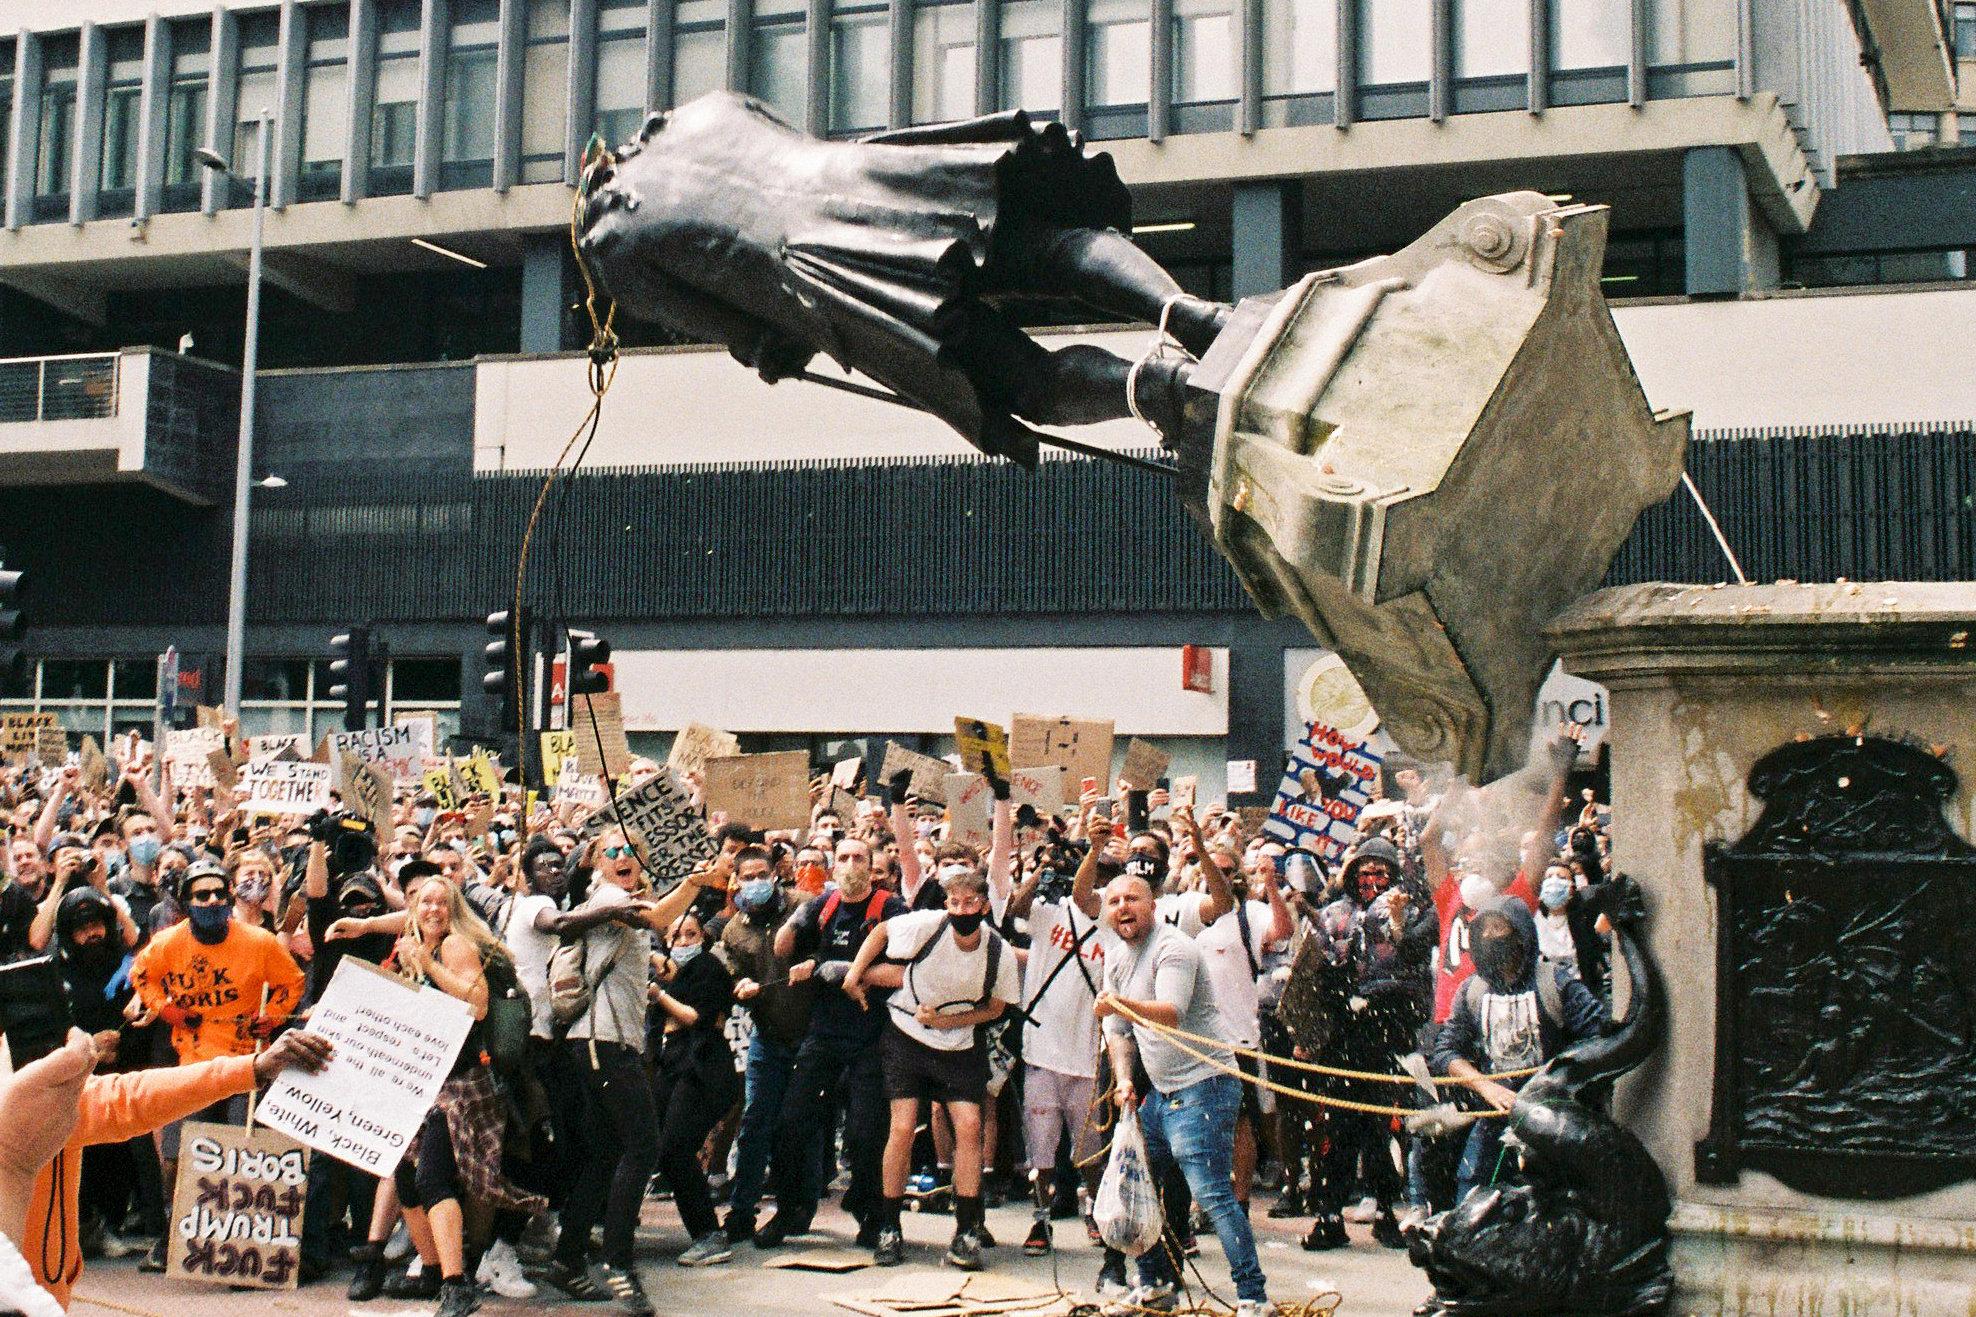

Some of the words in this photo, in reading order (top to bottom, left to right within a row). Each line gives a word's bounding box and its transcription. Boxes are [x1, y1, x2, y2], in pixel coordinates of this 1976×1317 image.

[335, 724, 411, 750] RACISM
[1310, 720, 1357, 751] HOW
[251, 762, 277, 777] WE
[288, 763, 329, 780] STAND
[1311, 744, 1376, 780] WOULD
[249, 778, 323, 802] TOGETHER
[1278, 799, 1319, 829] LIKE
[1322, 797, 1358, 820] YOU
[323, 1007, 348, 1023] and
[356, 1022, 402, 1048] respect
[393, 1020, 422, 1038] each
[343, 1036, 365, 1052] our
[423, 1033, 449, 1053] love
[346, 1054, 365, 1072] the
[366, 1042, 433, 1081] underneath
[412, 1046, 443, 1068] Let's
[370, 1065, 386, 1079] all
[267, 1100, 320, 1138] White,
[349, 1110, 405, 1148] Green,
[329, 1128, 383, 1166] Black,
[190, 1136, 308, 1188] BORIS
[196, 1175, 305, 1219] FUCK
[179, 1204, 301, 1248] TRUMP
[181, 1236, 297, 1286] FUCK
